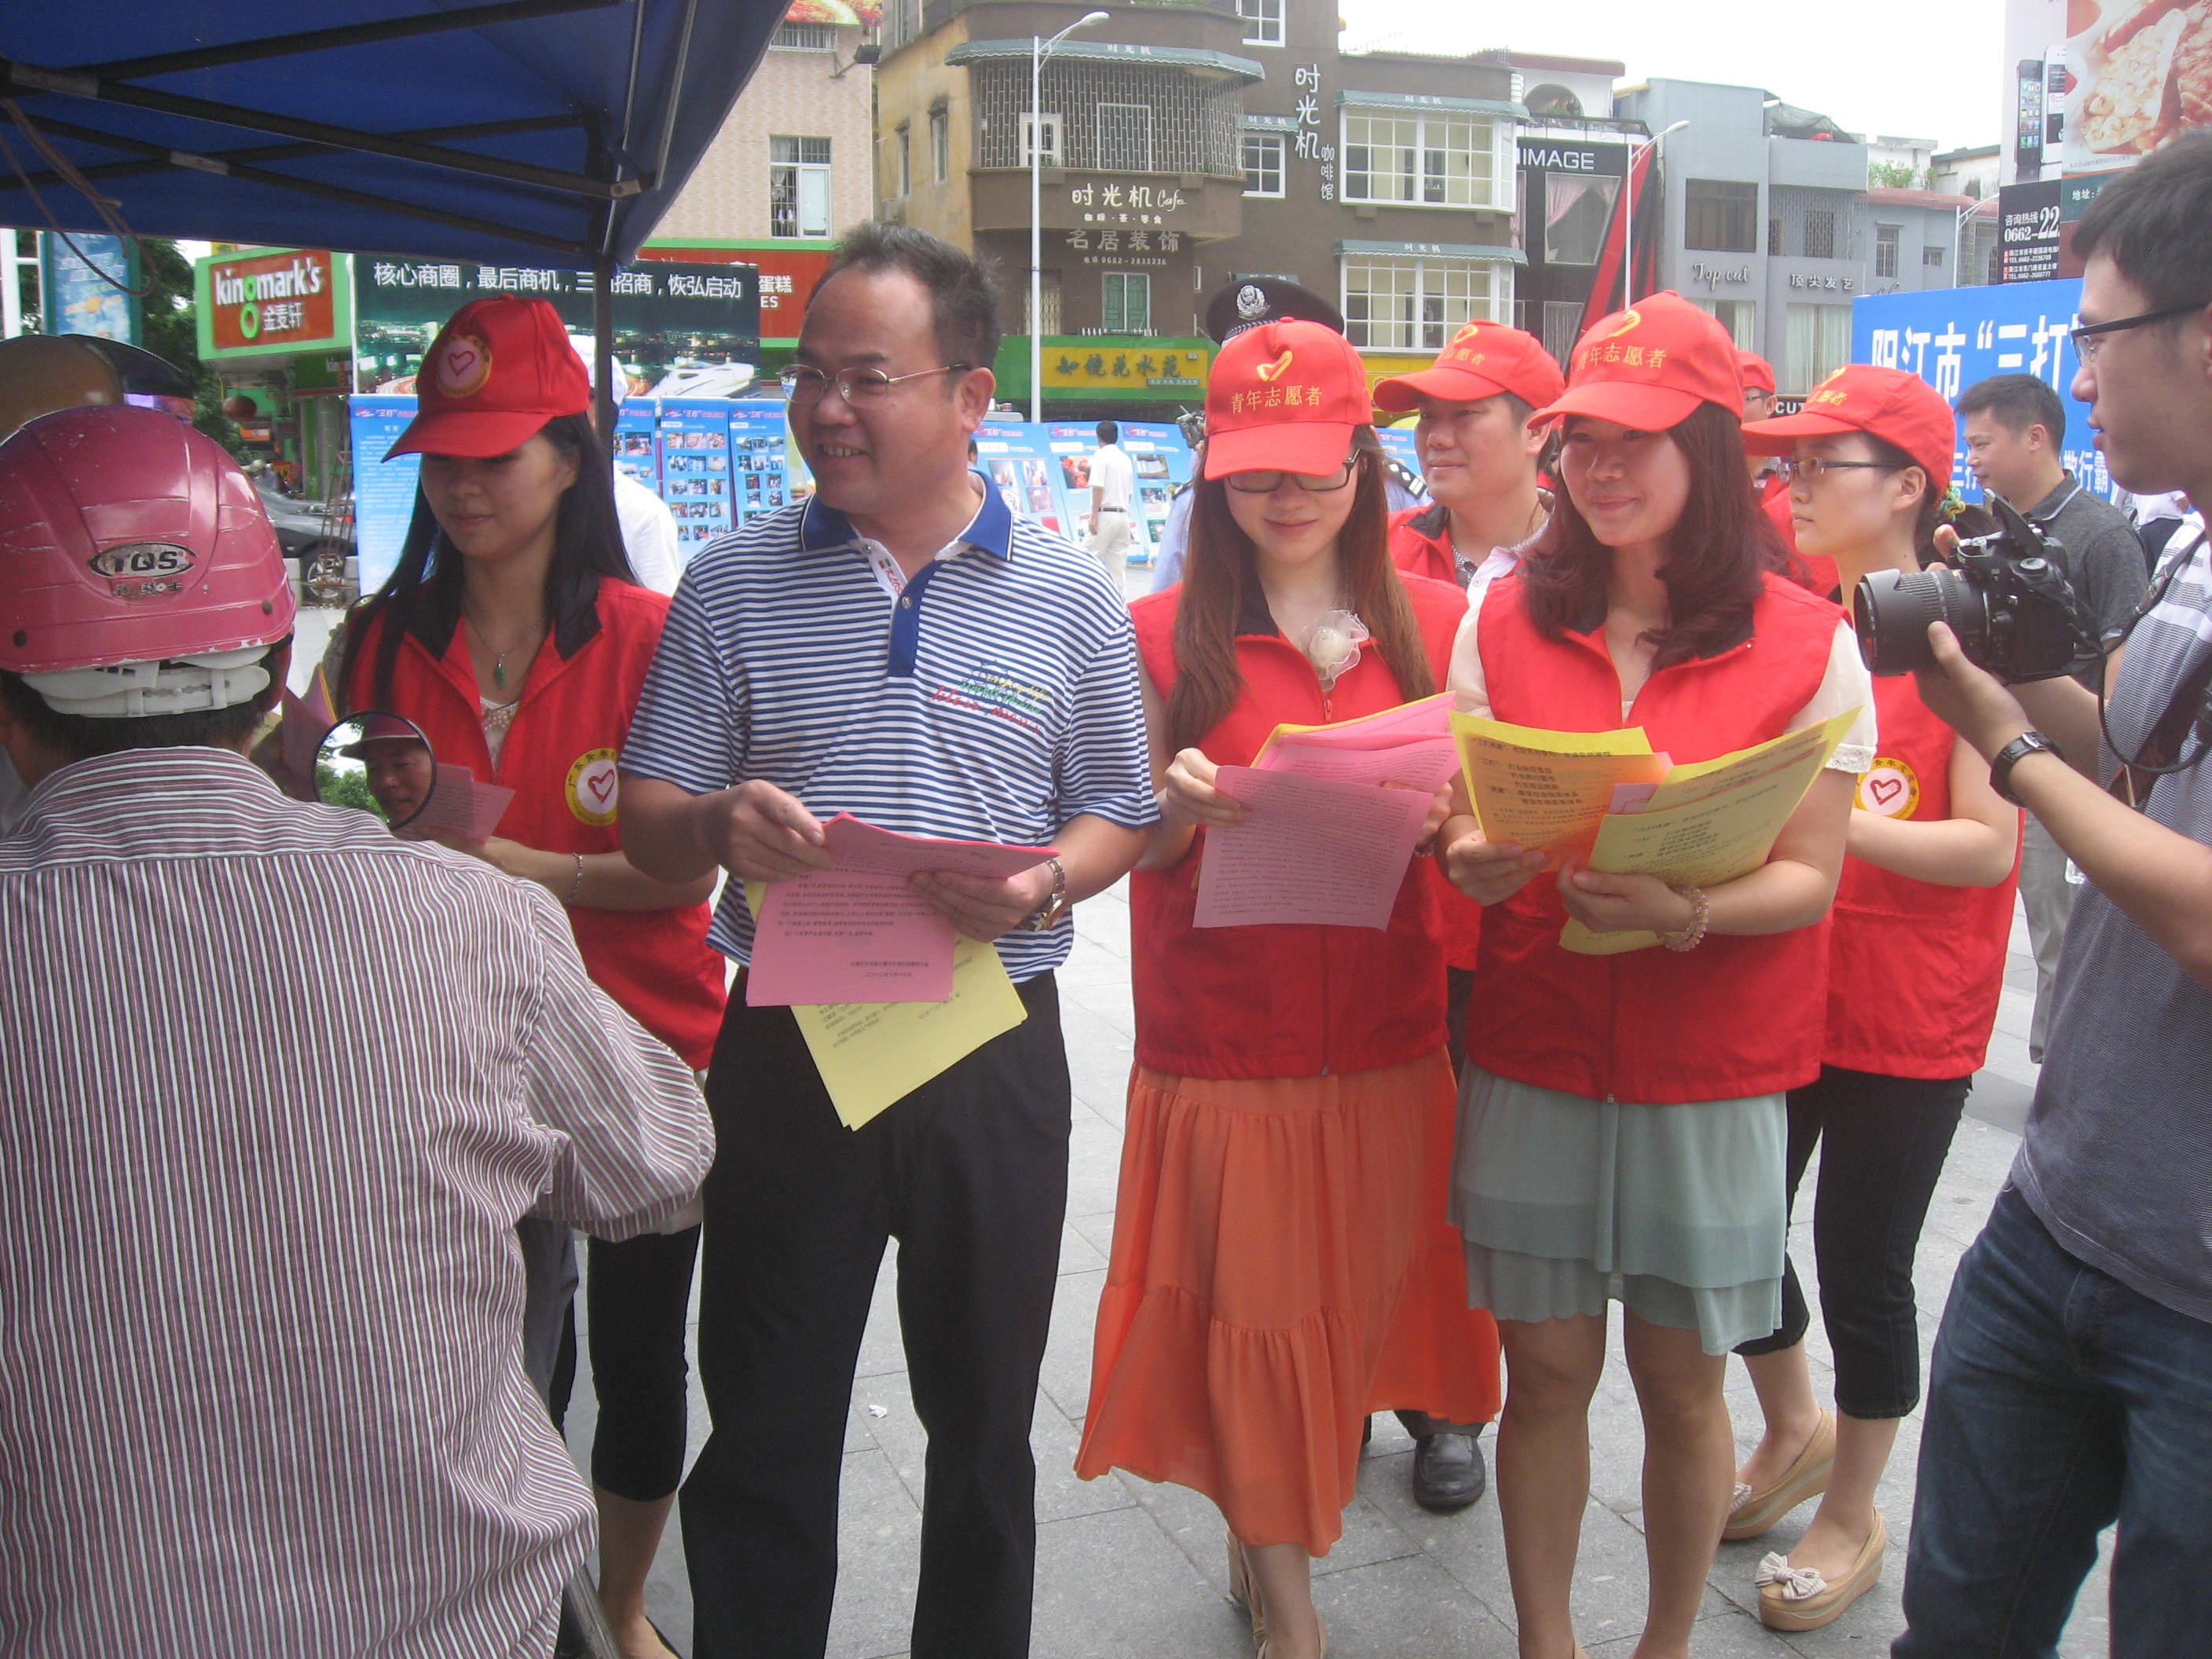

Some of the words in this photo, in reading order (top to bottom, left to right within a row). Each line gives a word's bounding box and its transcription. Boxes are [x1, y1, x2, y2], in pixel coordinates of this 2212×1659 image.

[1295, 63, 1321, 159] 时光机
[1320, 144, 1335, 200] 咖啡馆
[1071, 182, 1153, 208] 时光机
[2005, 211, 2039, 226] 咨询热线
[1066, 228, 1180, 251] 名居装饰
[1791, 273, 1854, 291] 顶尖发艺
[263, 302, 302, 331] 金麦轩
[1231, 384, 1323, 415] 青年志愿者
